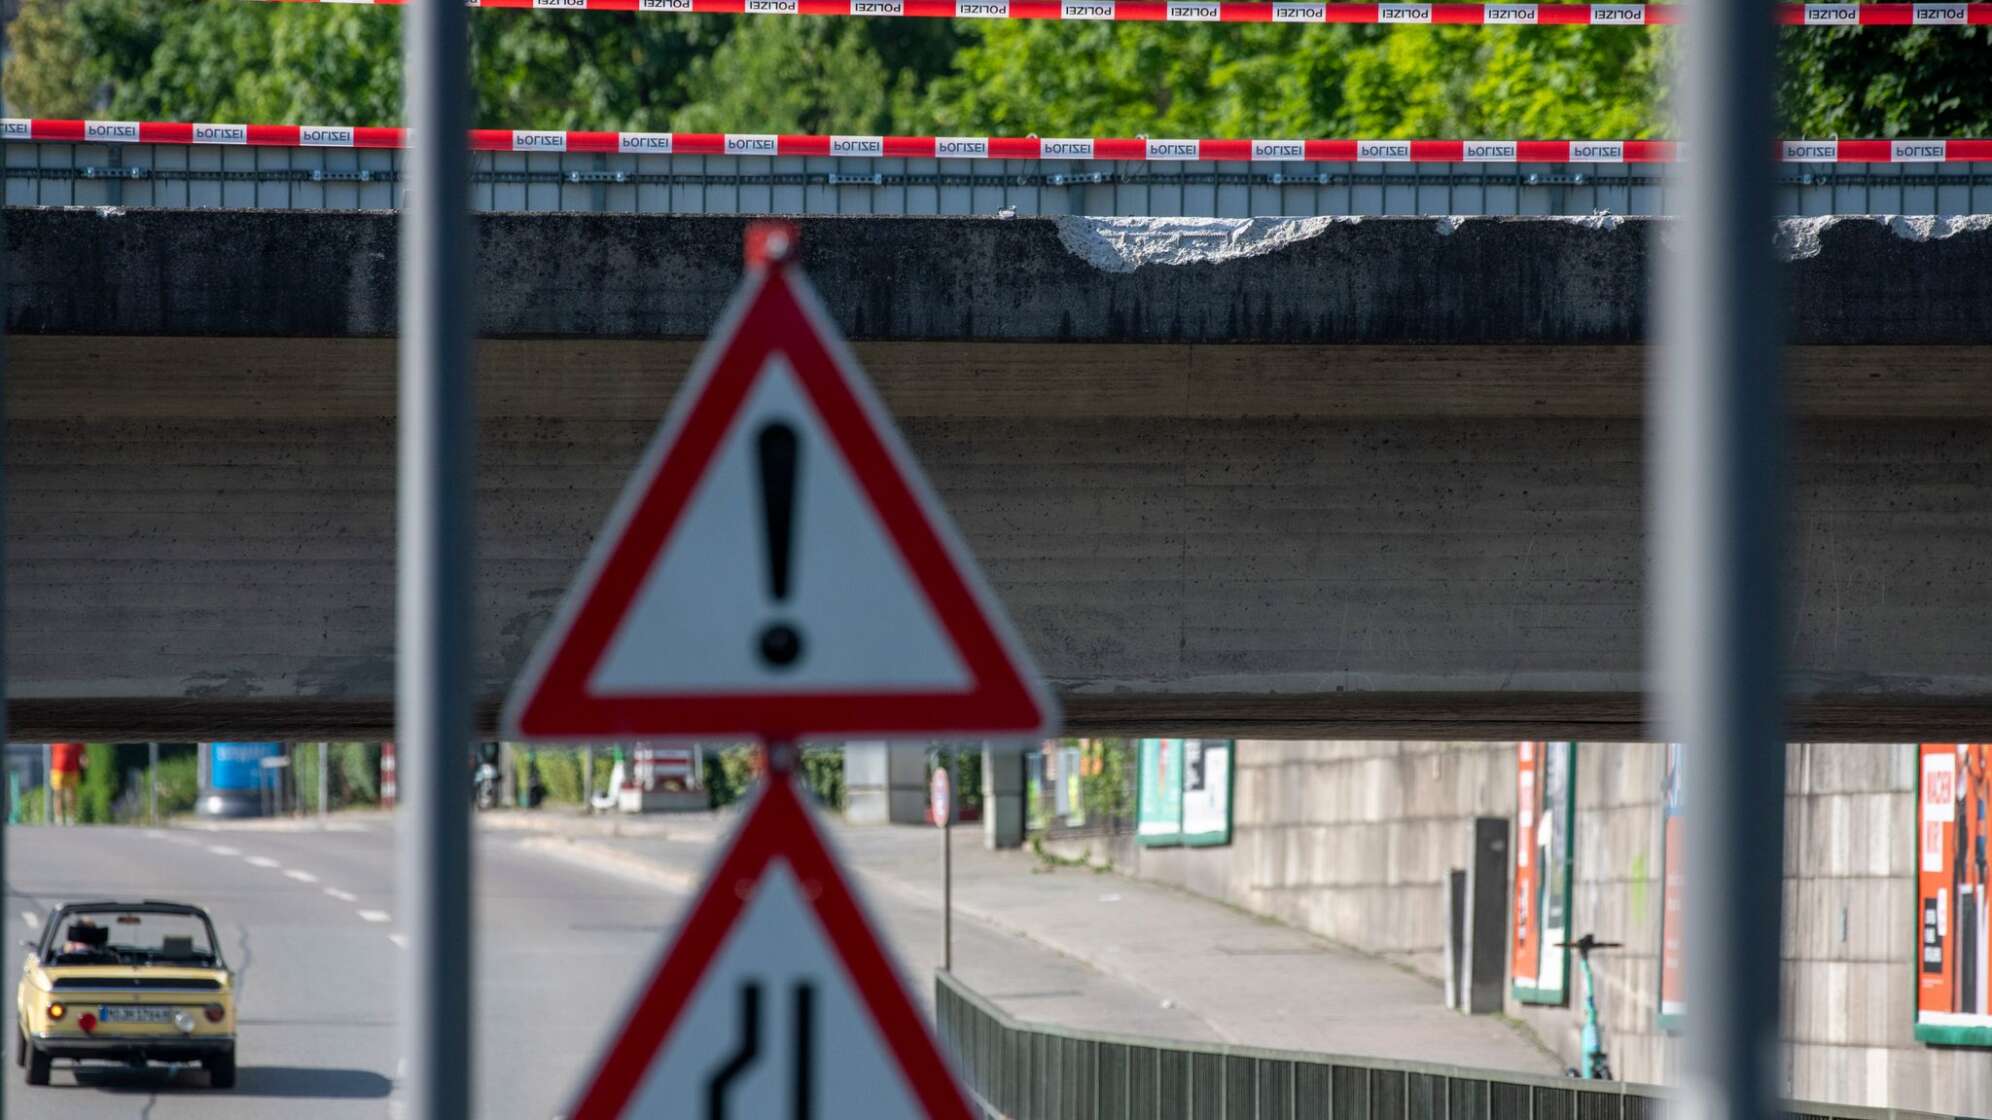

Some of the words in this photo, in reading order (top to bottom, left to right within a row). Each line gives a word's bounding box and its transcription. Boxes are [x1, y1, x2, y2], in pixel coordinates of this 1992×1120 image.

[644, 0, 689, 8] POLIZEI
[750, 0, 796, 9] POLIZEI
[855, 3, 901, 13] POLIZEI
[961, 5, 1007, 14] POLIZEI
[1066, 7, 1112, 16] POLIZEI
[1172, 8, 1217, 17] POLIZEI
[1277, 8, 1323, 18] POLIZEI
[1383, 9, 1429, 18] POLIZEI
[1595, 9, 1641, 19] POLIZEI
[1809, 9, 1855, 19] POLIZEI
[1918, 9, 1964, 19] POLIZEI
[1489, 10, 1534, 19] POLIZEI
